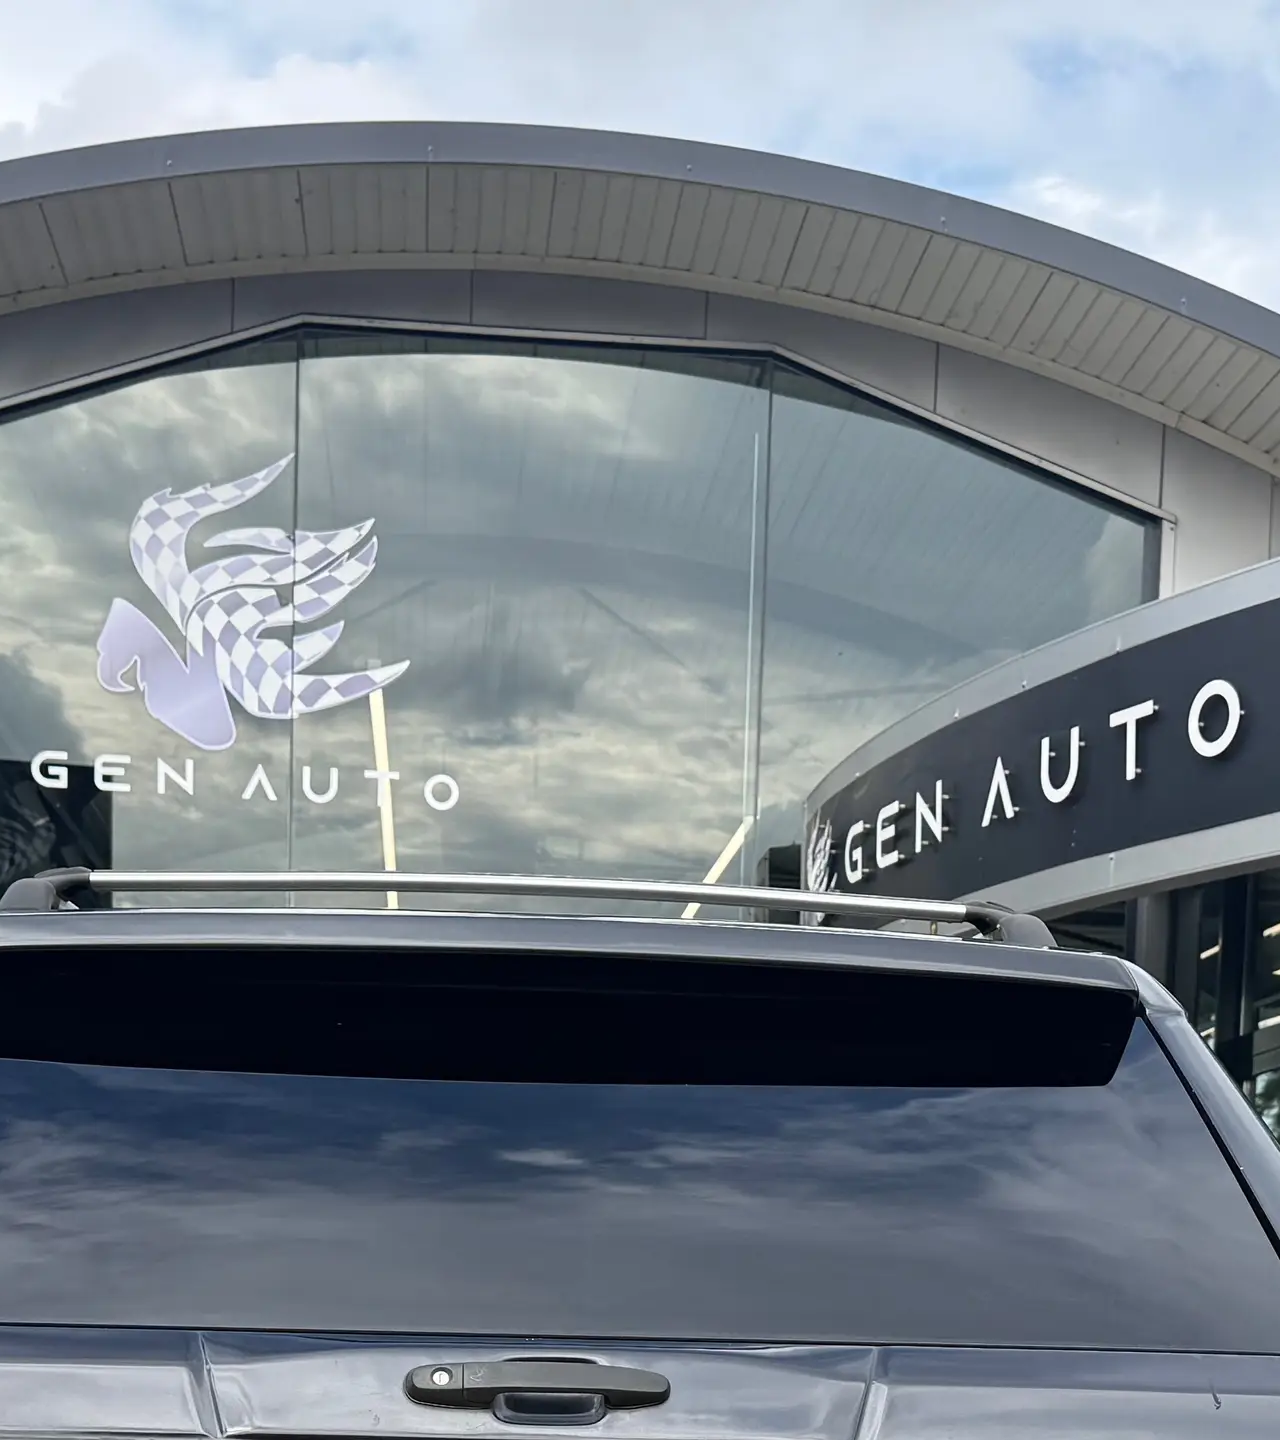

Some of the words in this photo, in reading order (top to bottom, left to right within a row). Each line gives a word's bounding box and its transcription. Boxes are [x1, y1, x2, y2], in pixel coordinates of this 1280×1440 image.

[31, 750, 195, 796] GEN
[242, 763, 460, 811] AUTO
[843, 779, 944, 884] GEN
[981, 678, 1242, 828] AUTO
